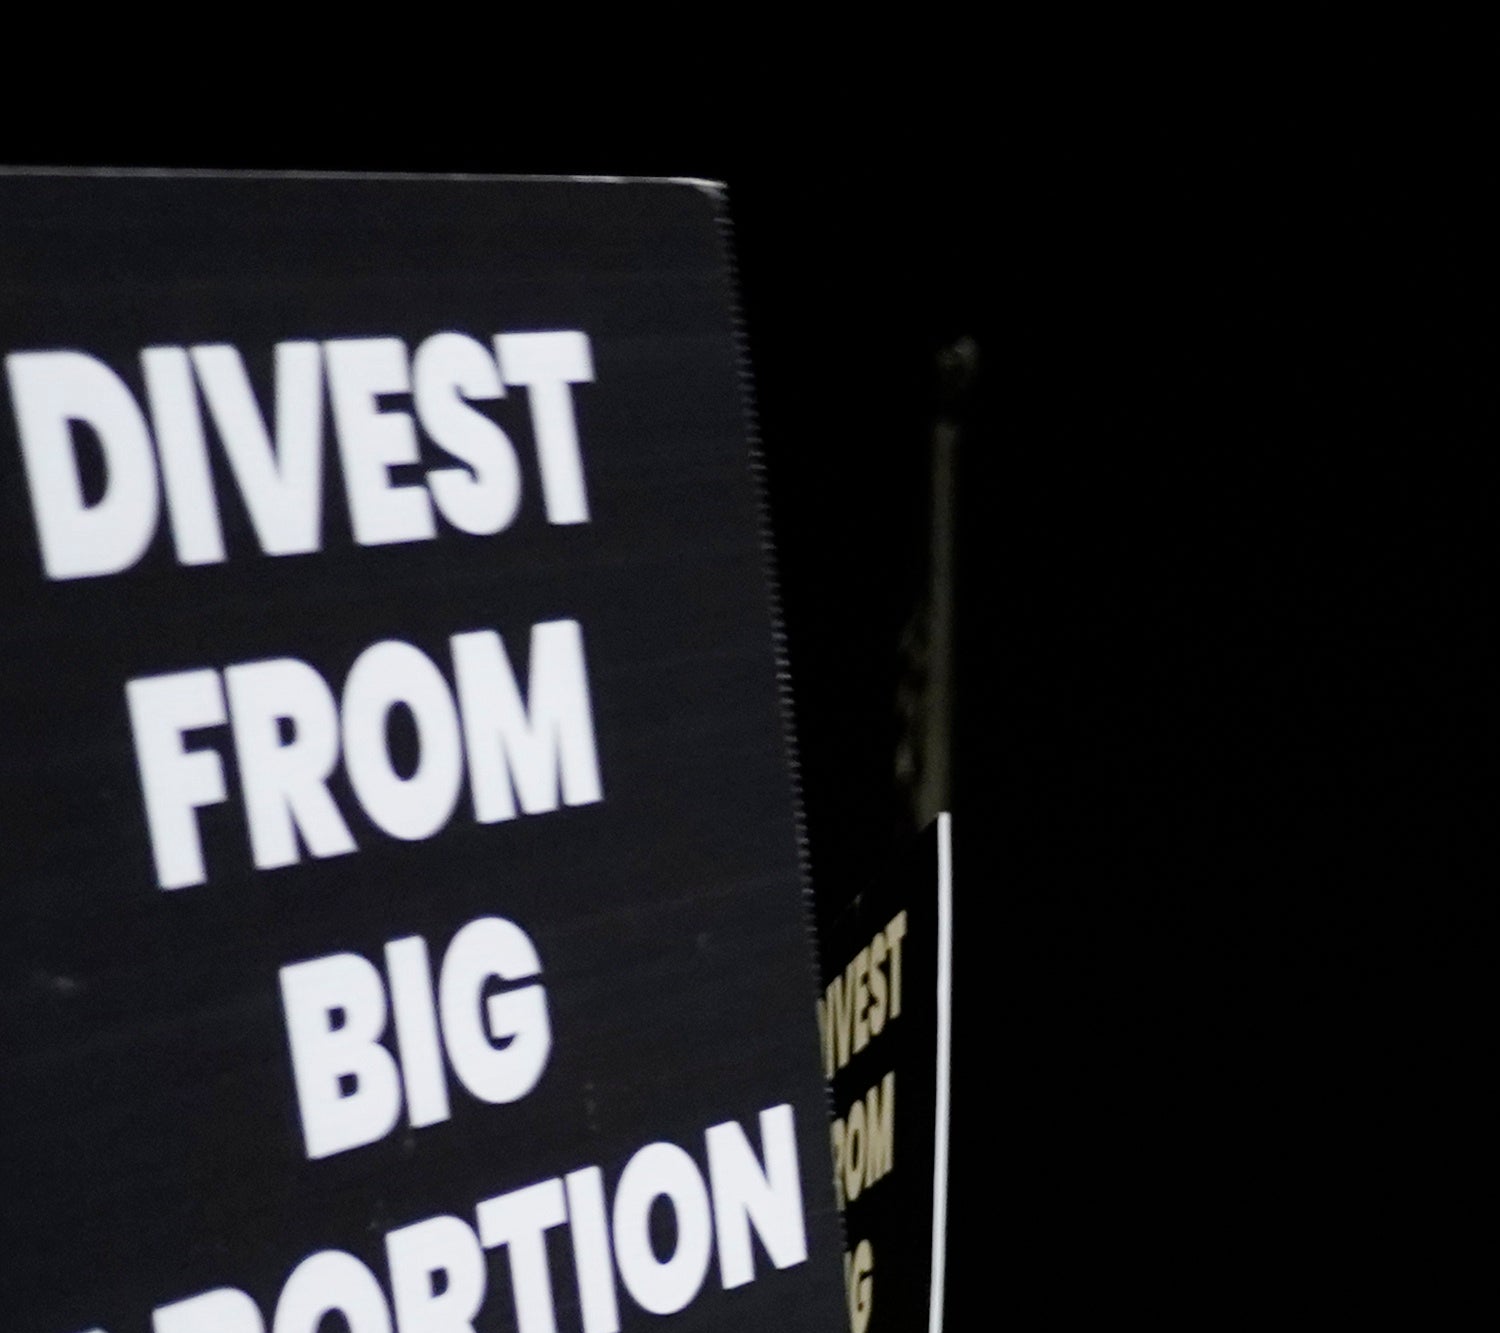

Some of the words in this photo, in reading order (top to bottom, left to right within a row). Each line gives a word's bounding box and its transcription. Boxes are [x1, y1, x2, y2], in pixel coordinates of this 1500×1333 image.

[4, 330, 595, 580] DIVEST
[126, 619, 604, 890] FROM
[279, 915, 552, 1159] BIG
[816, 909, 908, 1081] IVEST
